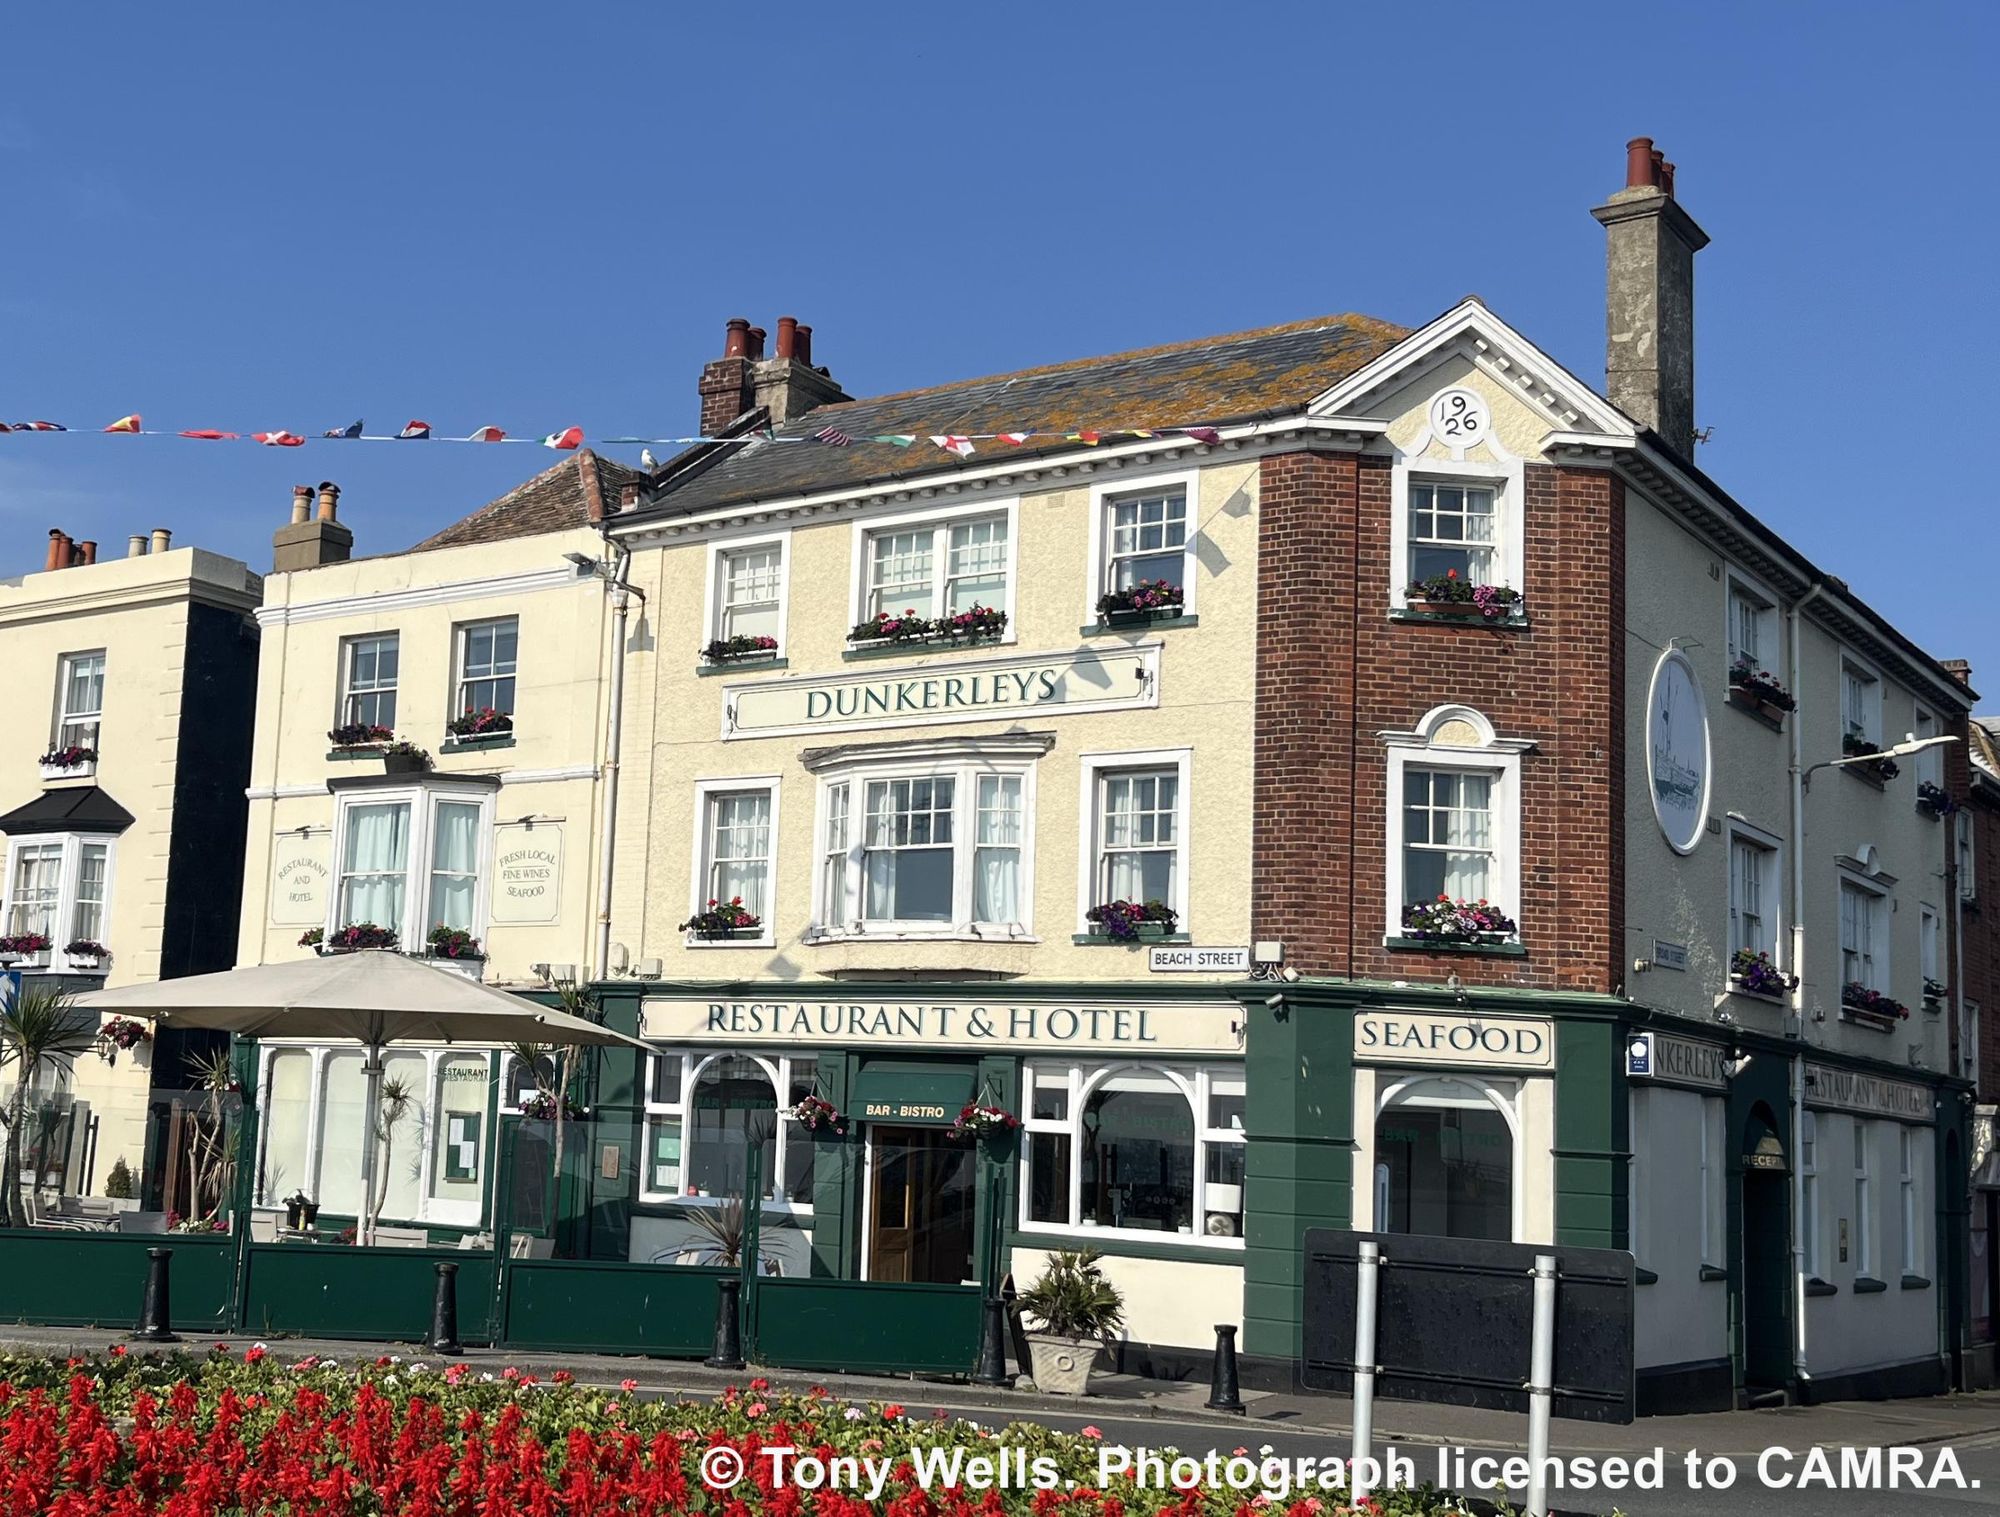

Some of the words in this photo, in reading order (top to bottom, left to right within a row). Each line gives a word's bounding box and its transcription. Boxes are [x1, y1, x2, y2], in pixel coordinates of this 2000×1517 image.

[806, 669, 1056, 719] DUNKERLEYS
[499, 850, 526, 867] FRESH
[528, 850, 556, 865] LOCAL
[278, 858, 328, 880] RESTAURANT
[503, 869, 521, 880] FINE
[523, 869, 551, 879] WINES
[293, 875, 311, 885] AND
[289, 891, 313, 902] HOTEL
[507, 885, 545, 898] SEAFOOD
[1155, 952, 1192, 965] BEACH
[1198, 952, 1243, 965] STREET
[706, 1004, 956, 1037] RESTAURANT
[966, 1007, 998, 1038] &
[1008, 1008, 1158, 1042] HOTEL
[1362, 1021, 1542, 1055] SEAFOOD
[439, 1067, 489, 1077] RESTAURANT
[866, 1104, 890, 1116] BAR
[900, 1105, 945, 1118] BISTRO
